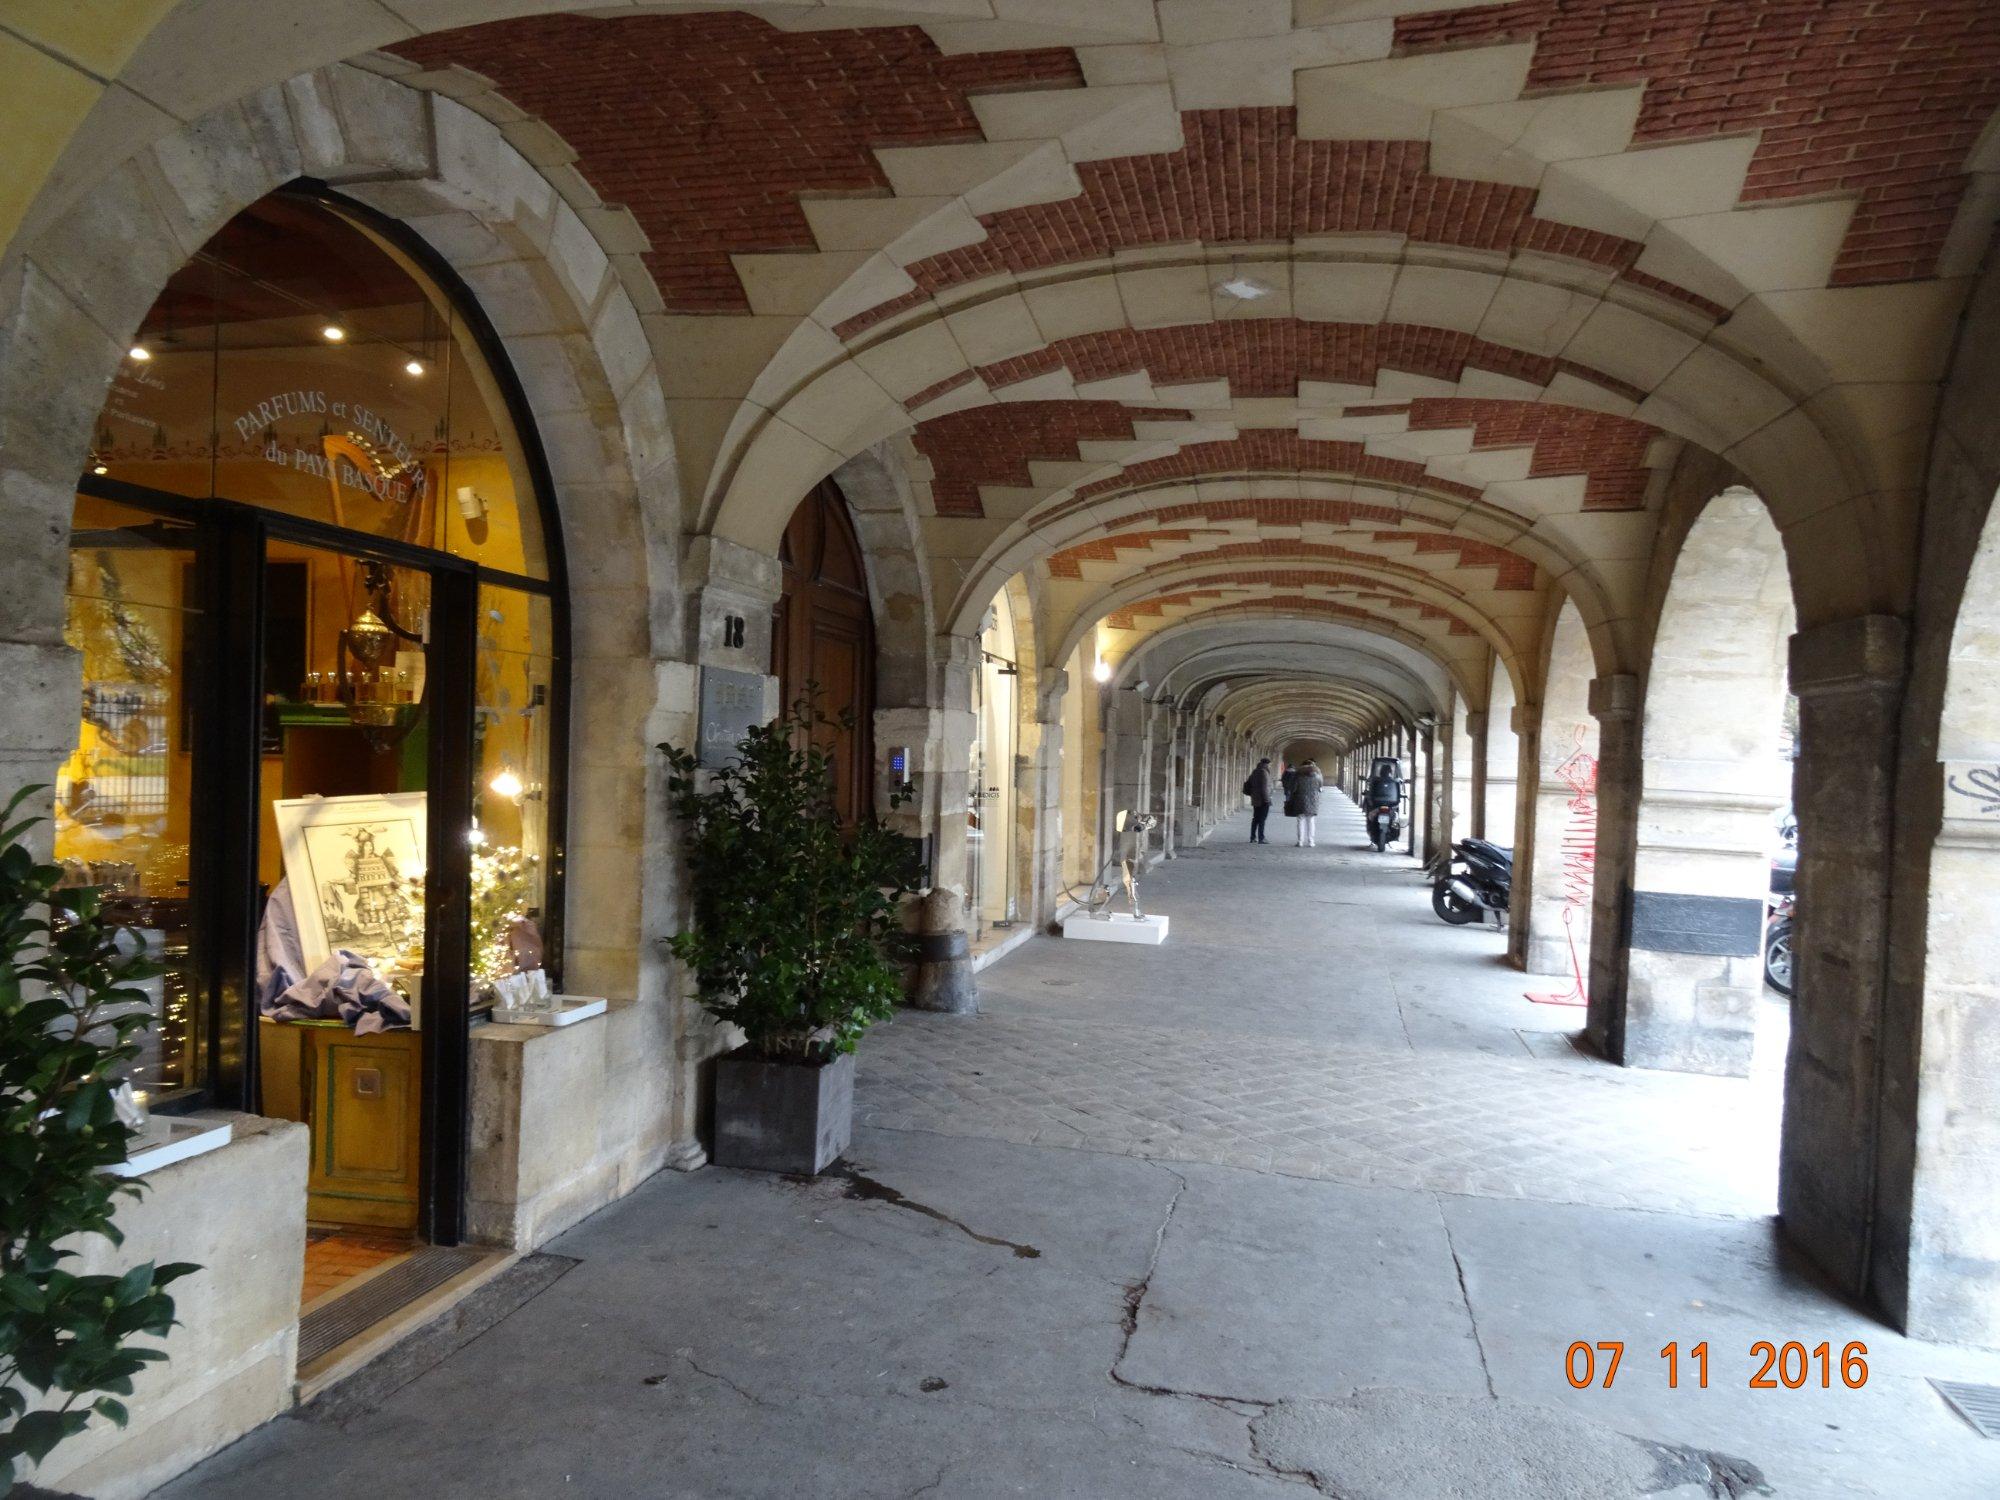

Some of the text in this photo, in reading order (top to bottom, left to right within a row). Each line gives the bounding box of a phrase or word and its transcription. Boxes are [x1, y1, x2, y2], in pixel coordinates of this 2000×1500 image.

[234, 391, 328, 442] PARFUMS
[332, 402, 347, 419] et
[266, 440, 287, 466] du
[342, 464, 408, 503] BASQUE
[723, 615, 745, 649] 18
